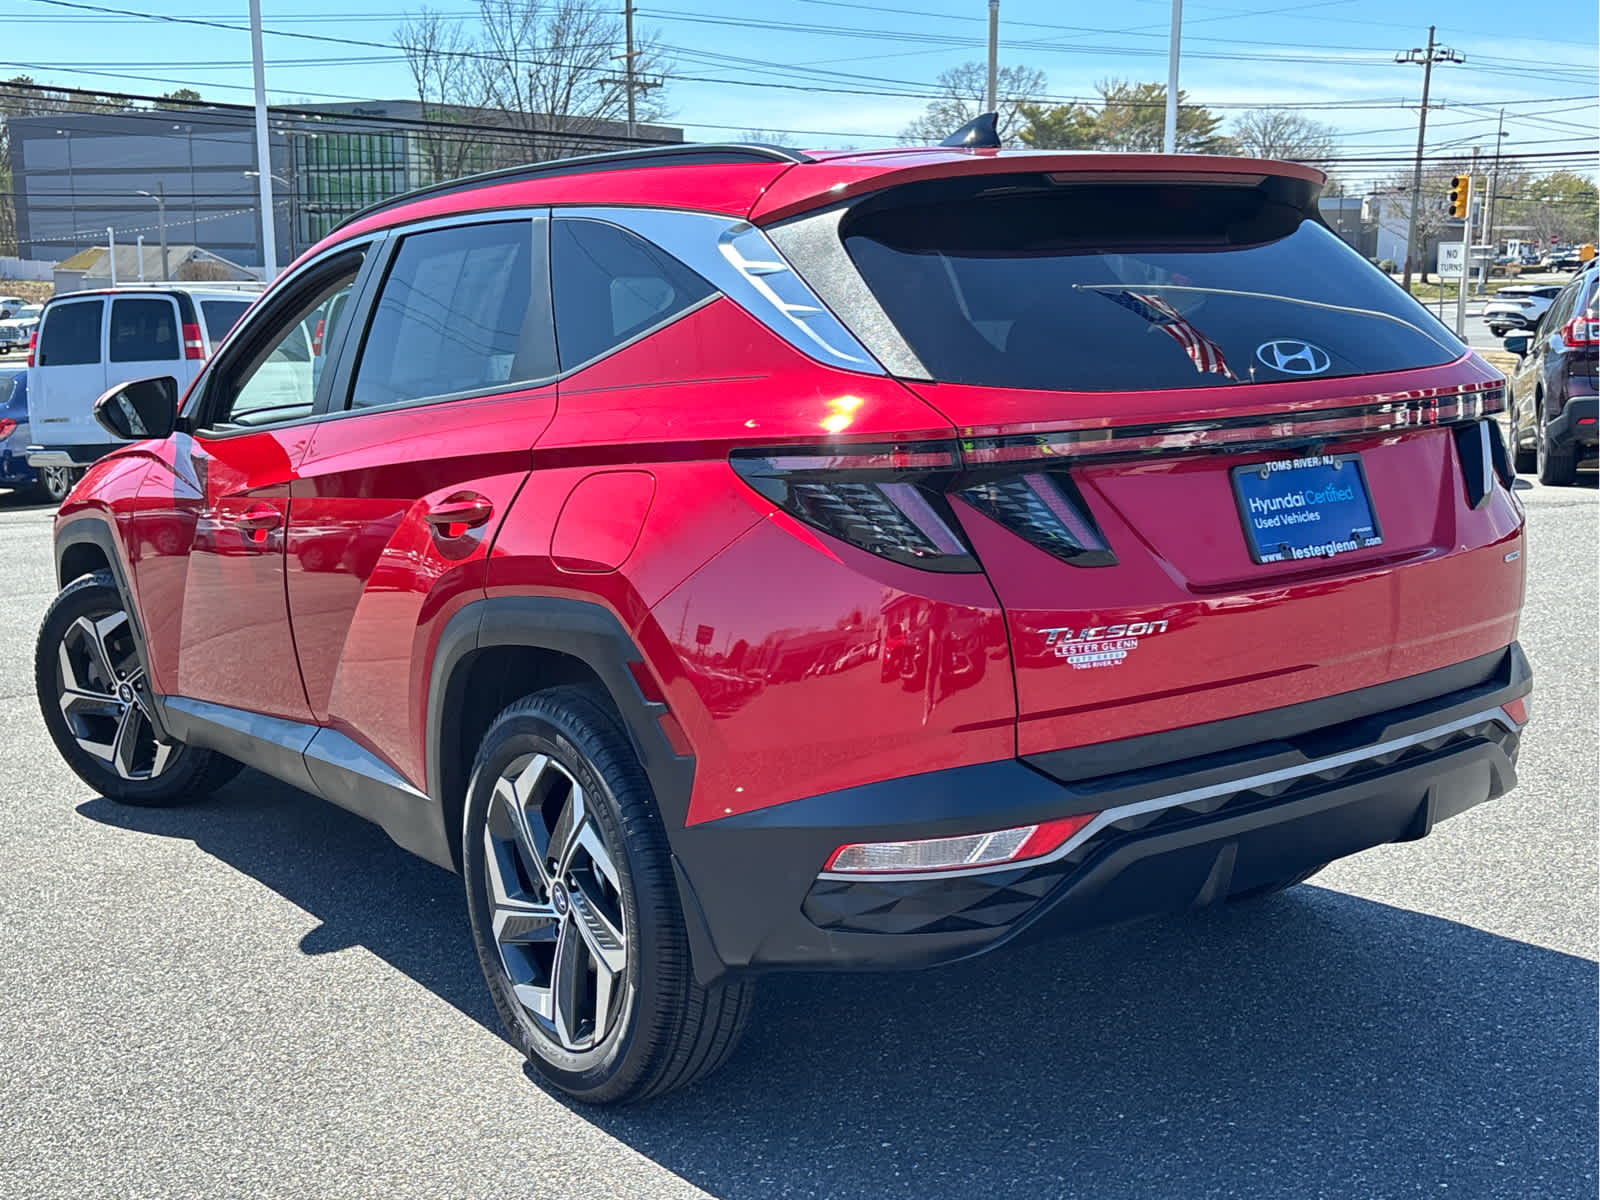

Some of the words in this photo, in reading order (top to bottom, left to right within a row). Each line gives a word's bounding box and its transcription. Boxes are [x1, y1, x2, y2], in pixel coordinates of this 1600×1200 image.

[1446, 249, 1458, 259] NO
[1440, 263, 1463, 272] TURNS
[1265, 460, 1292, 471] TOMS
[1323, 455, 1334, 465] NJ
[1248, 491, 1305, 514] Hyundai
[1305, 483, 1353, 505] Certified
[1254, 514, 1280, 529] Used
[1281, 511, 1320, 525] Vehicles
[1037, 620, 1169, 645] TUCSON
[1055, 643, 1098, 656] LESTER
[1101, 639, 1138, 651] GLENN
